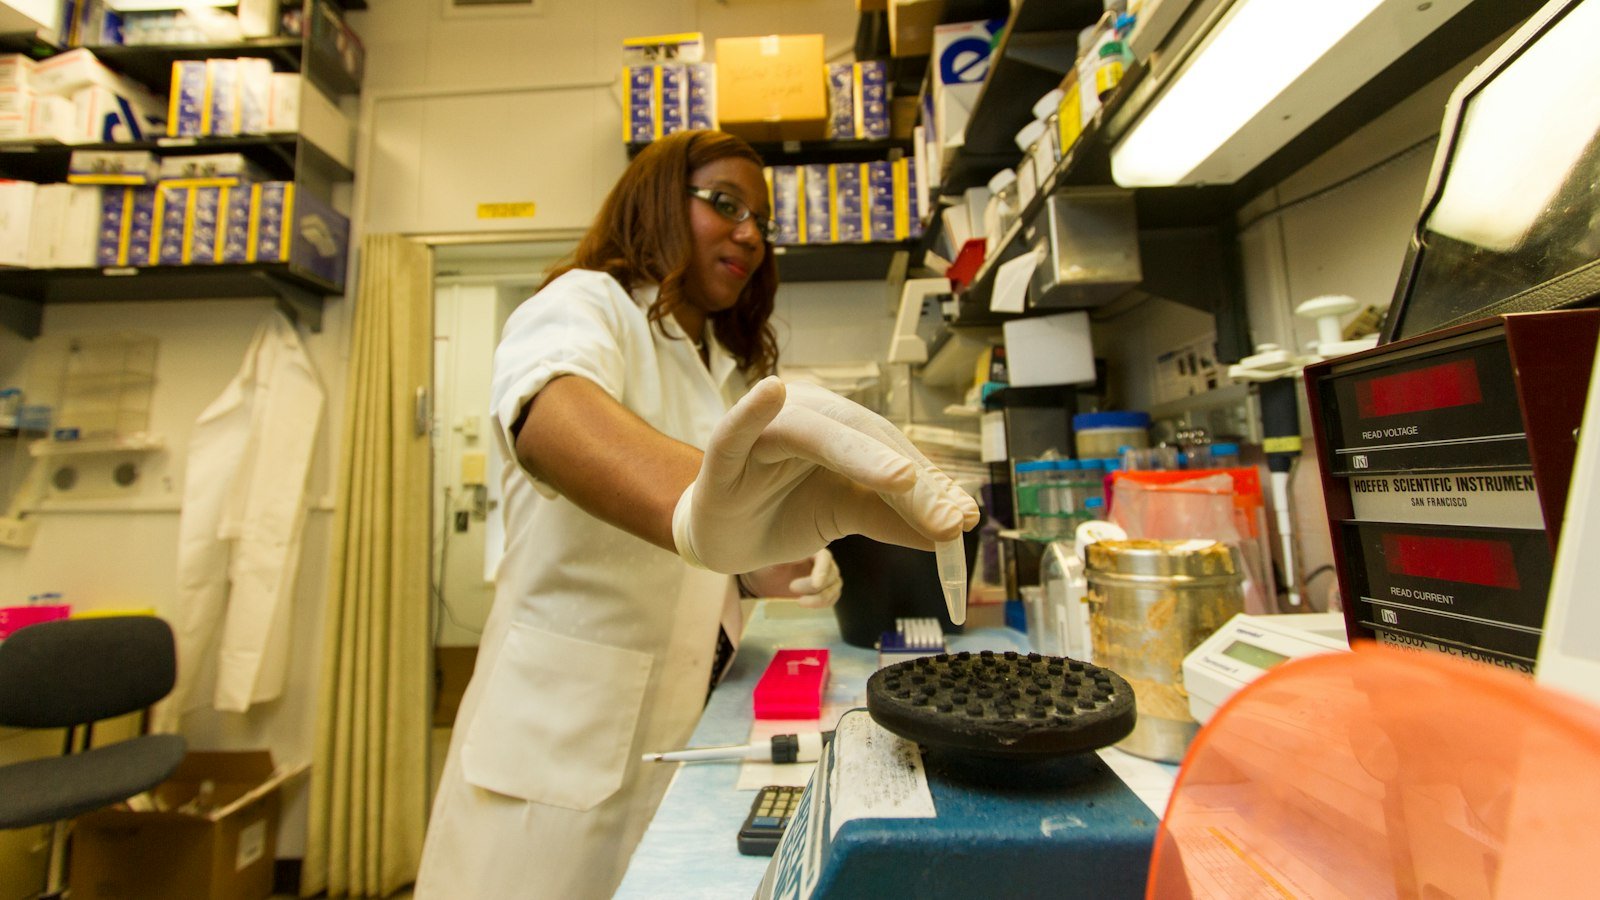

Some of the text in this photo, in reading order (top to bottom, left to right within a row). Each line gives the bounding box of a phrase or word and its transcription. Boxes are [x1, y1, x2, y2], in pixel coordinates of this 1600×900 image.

[1362, 425, 1419, 440] READ VOLTAGE
[1354, 474, 1537, 493] HOEFER SCIENTIFIC INSTRUMEN
[1411, 497, 1468, 507] SAN FRANCISCO
[1390, 586, 1455, 605] READ CURRENT
